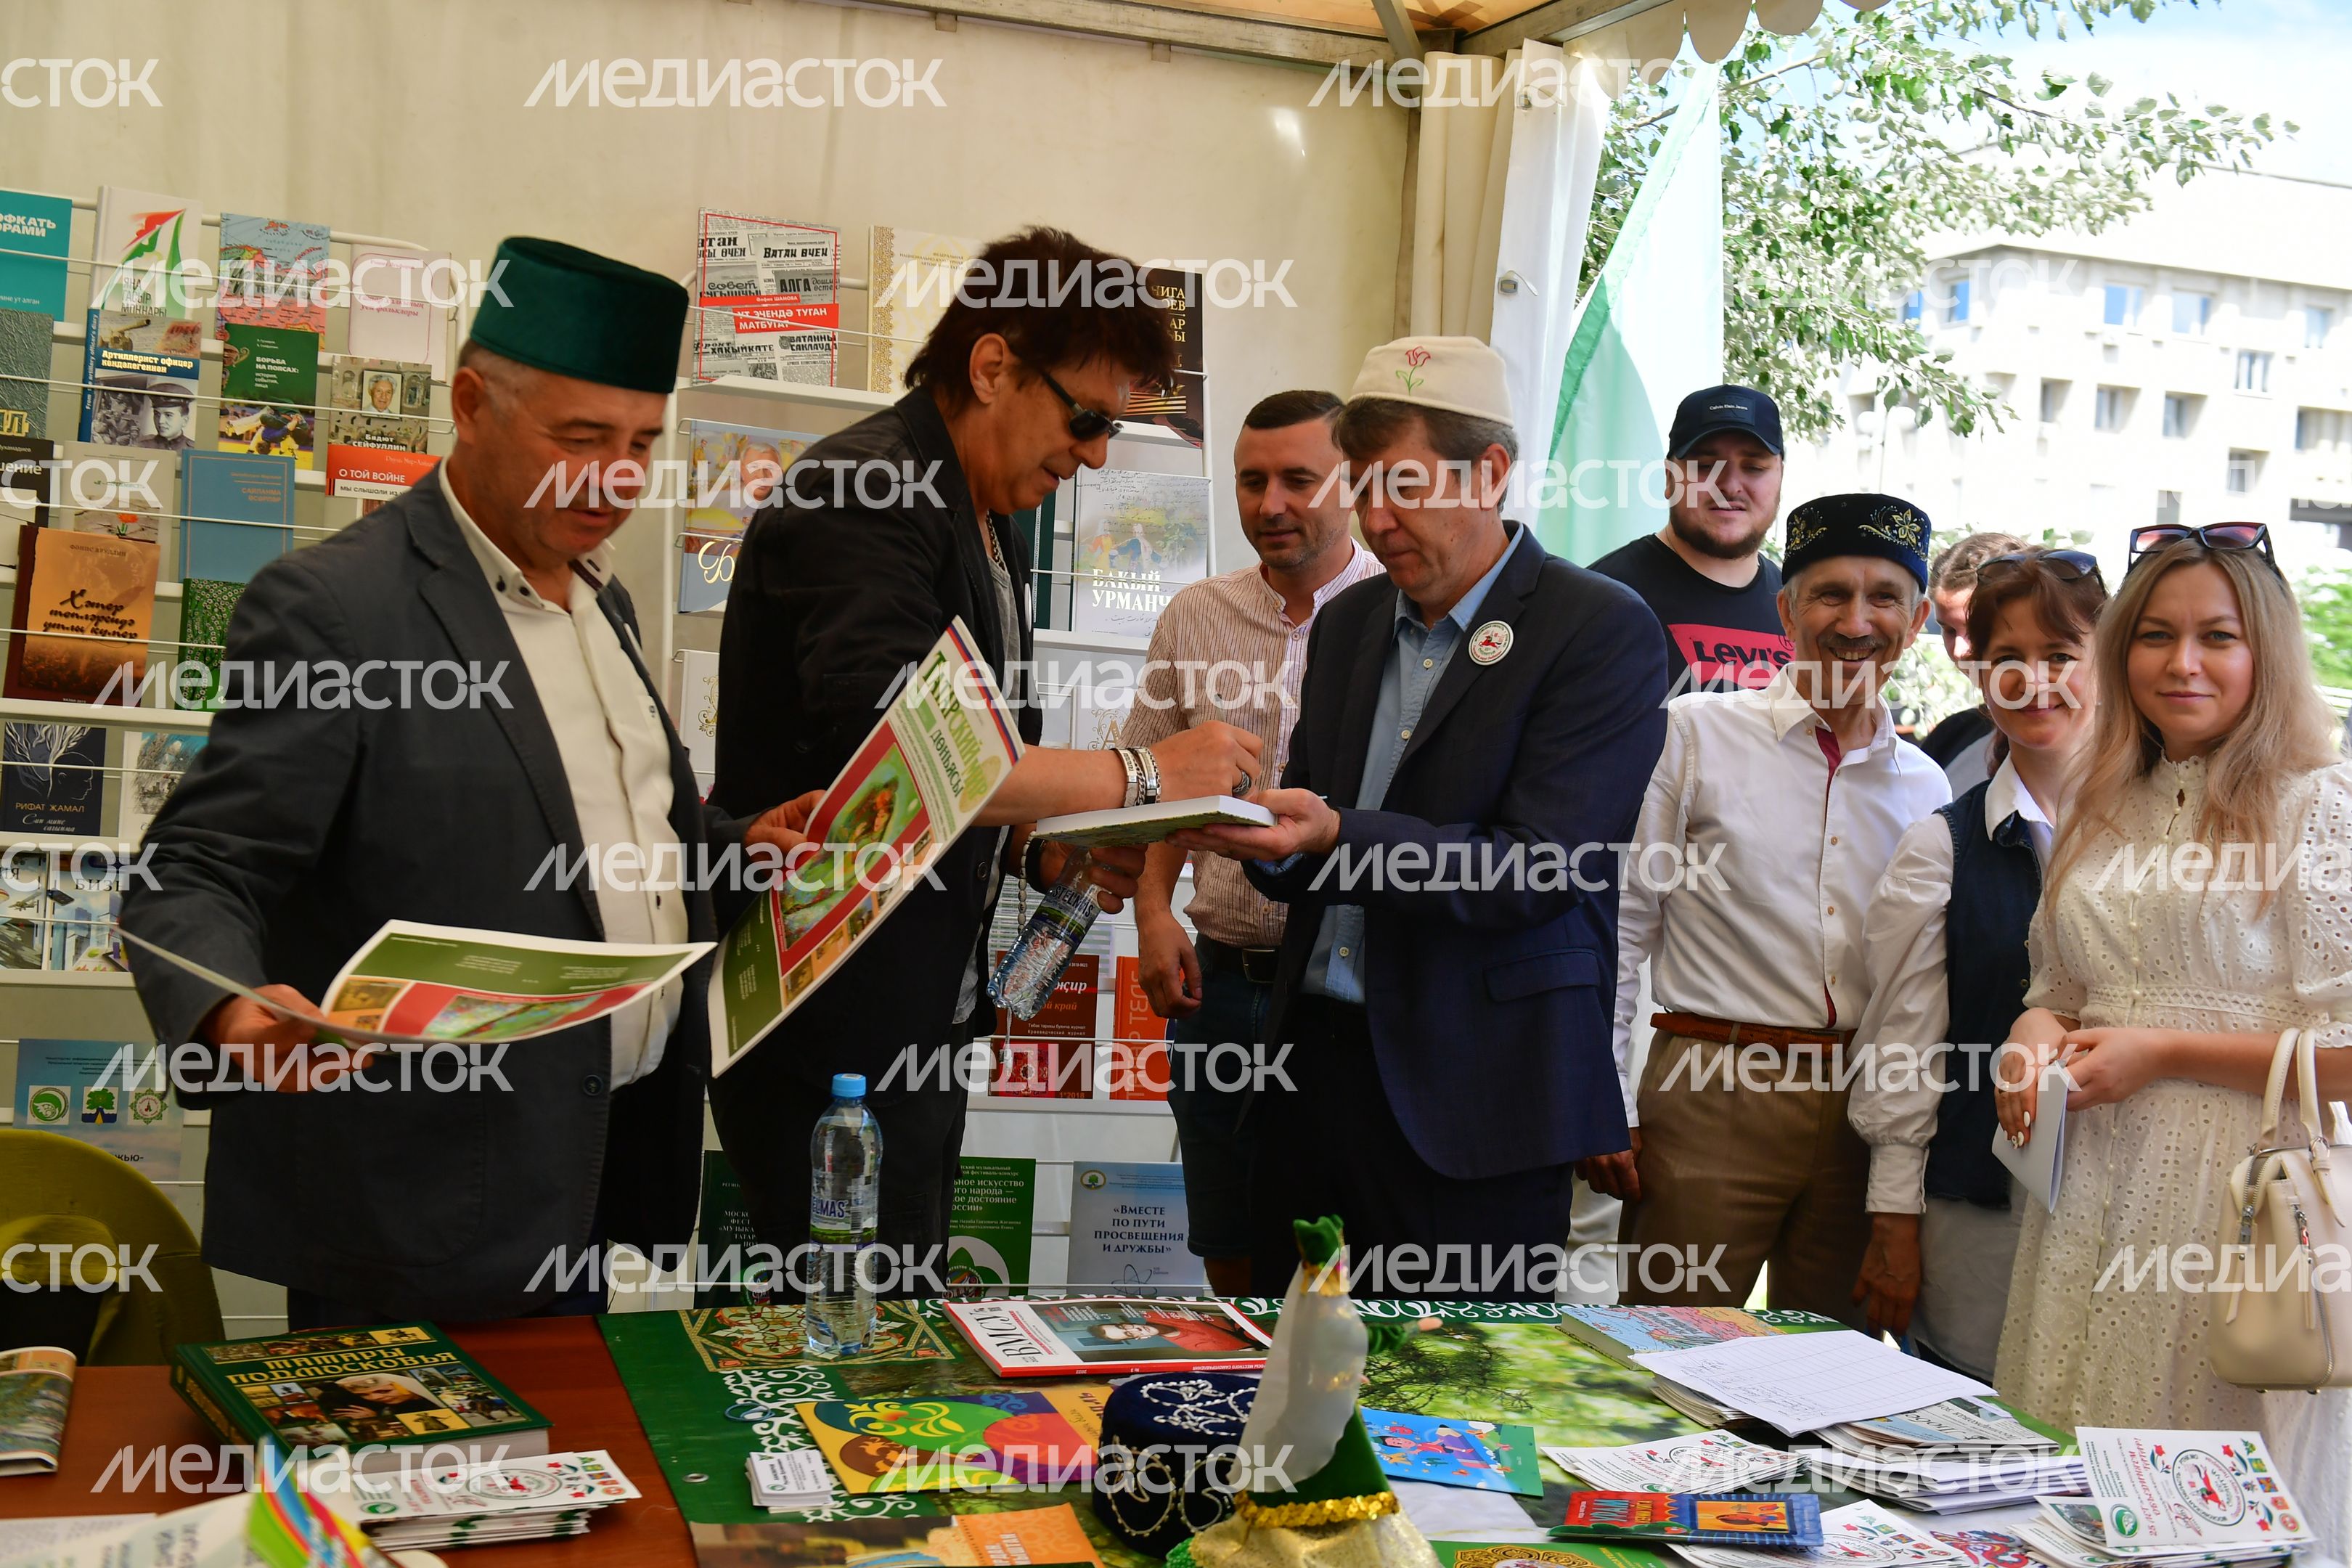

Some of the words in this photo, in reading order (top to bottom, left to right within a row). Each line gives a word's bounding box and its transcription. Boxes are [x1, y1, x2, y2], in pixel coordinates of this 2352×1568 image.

[793, 308, 828, 317] ТУГАН
[338, 468, 348, 477] О
[350, 469, 370, 480] ТОЙ
[372, 472, 406, 483] ВОЙНЕ
[1092, 568, 1161, 593] БАКЫЙ
[1092, 589, 1172, 613] УРМАНЧ
[15, 802, 46, 811] РИФАТ
[1054, 1002, 1078, 1011] край
[1112, 1218, 1130, 1228] ПО
[1133, 1219, 1165, 1228] ПУТИ
[1094, 1230, 1184, 1241] ПРОСВЕЩЕНИЯ
[1103, 1244, 1111, 1252] И
[1114, 1244, 1172, 1254] ДРУЖБЫ»
[263, 1347, 405, 1371] ТАТАРЫ
[226, 1352, 458, 1384] ПОДМОСКОВЬЯ
